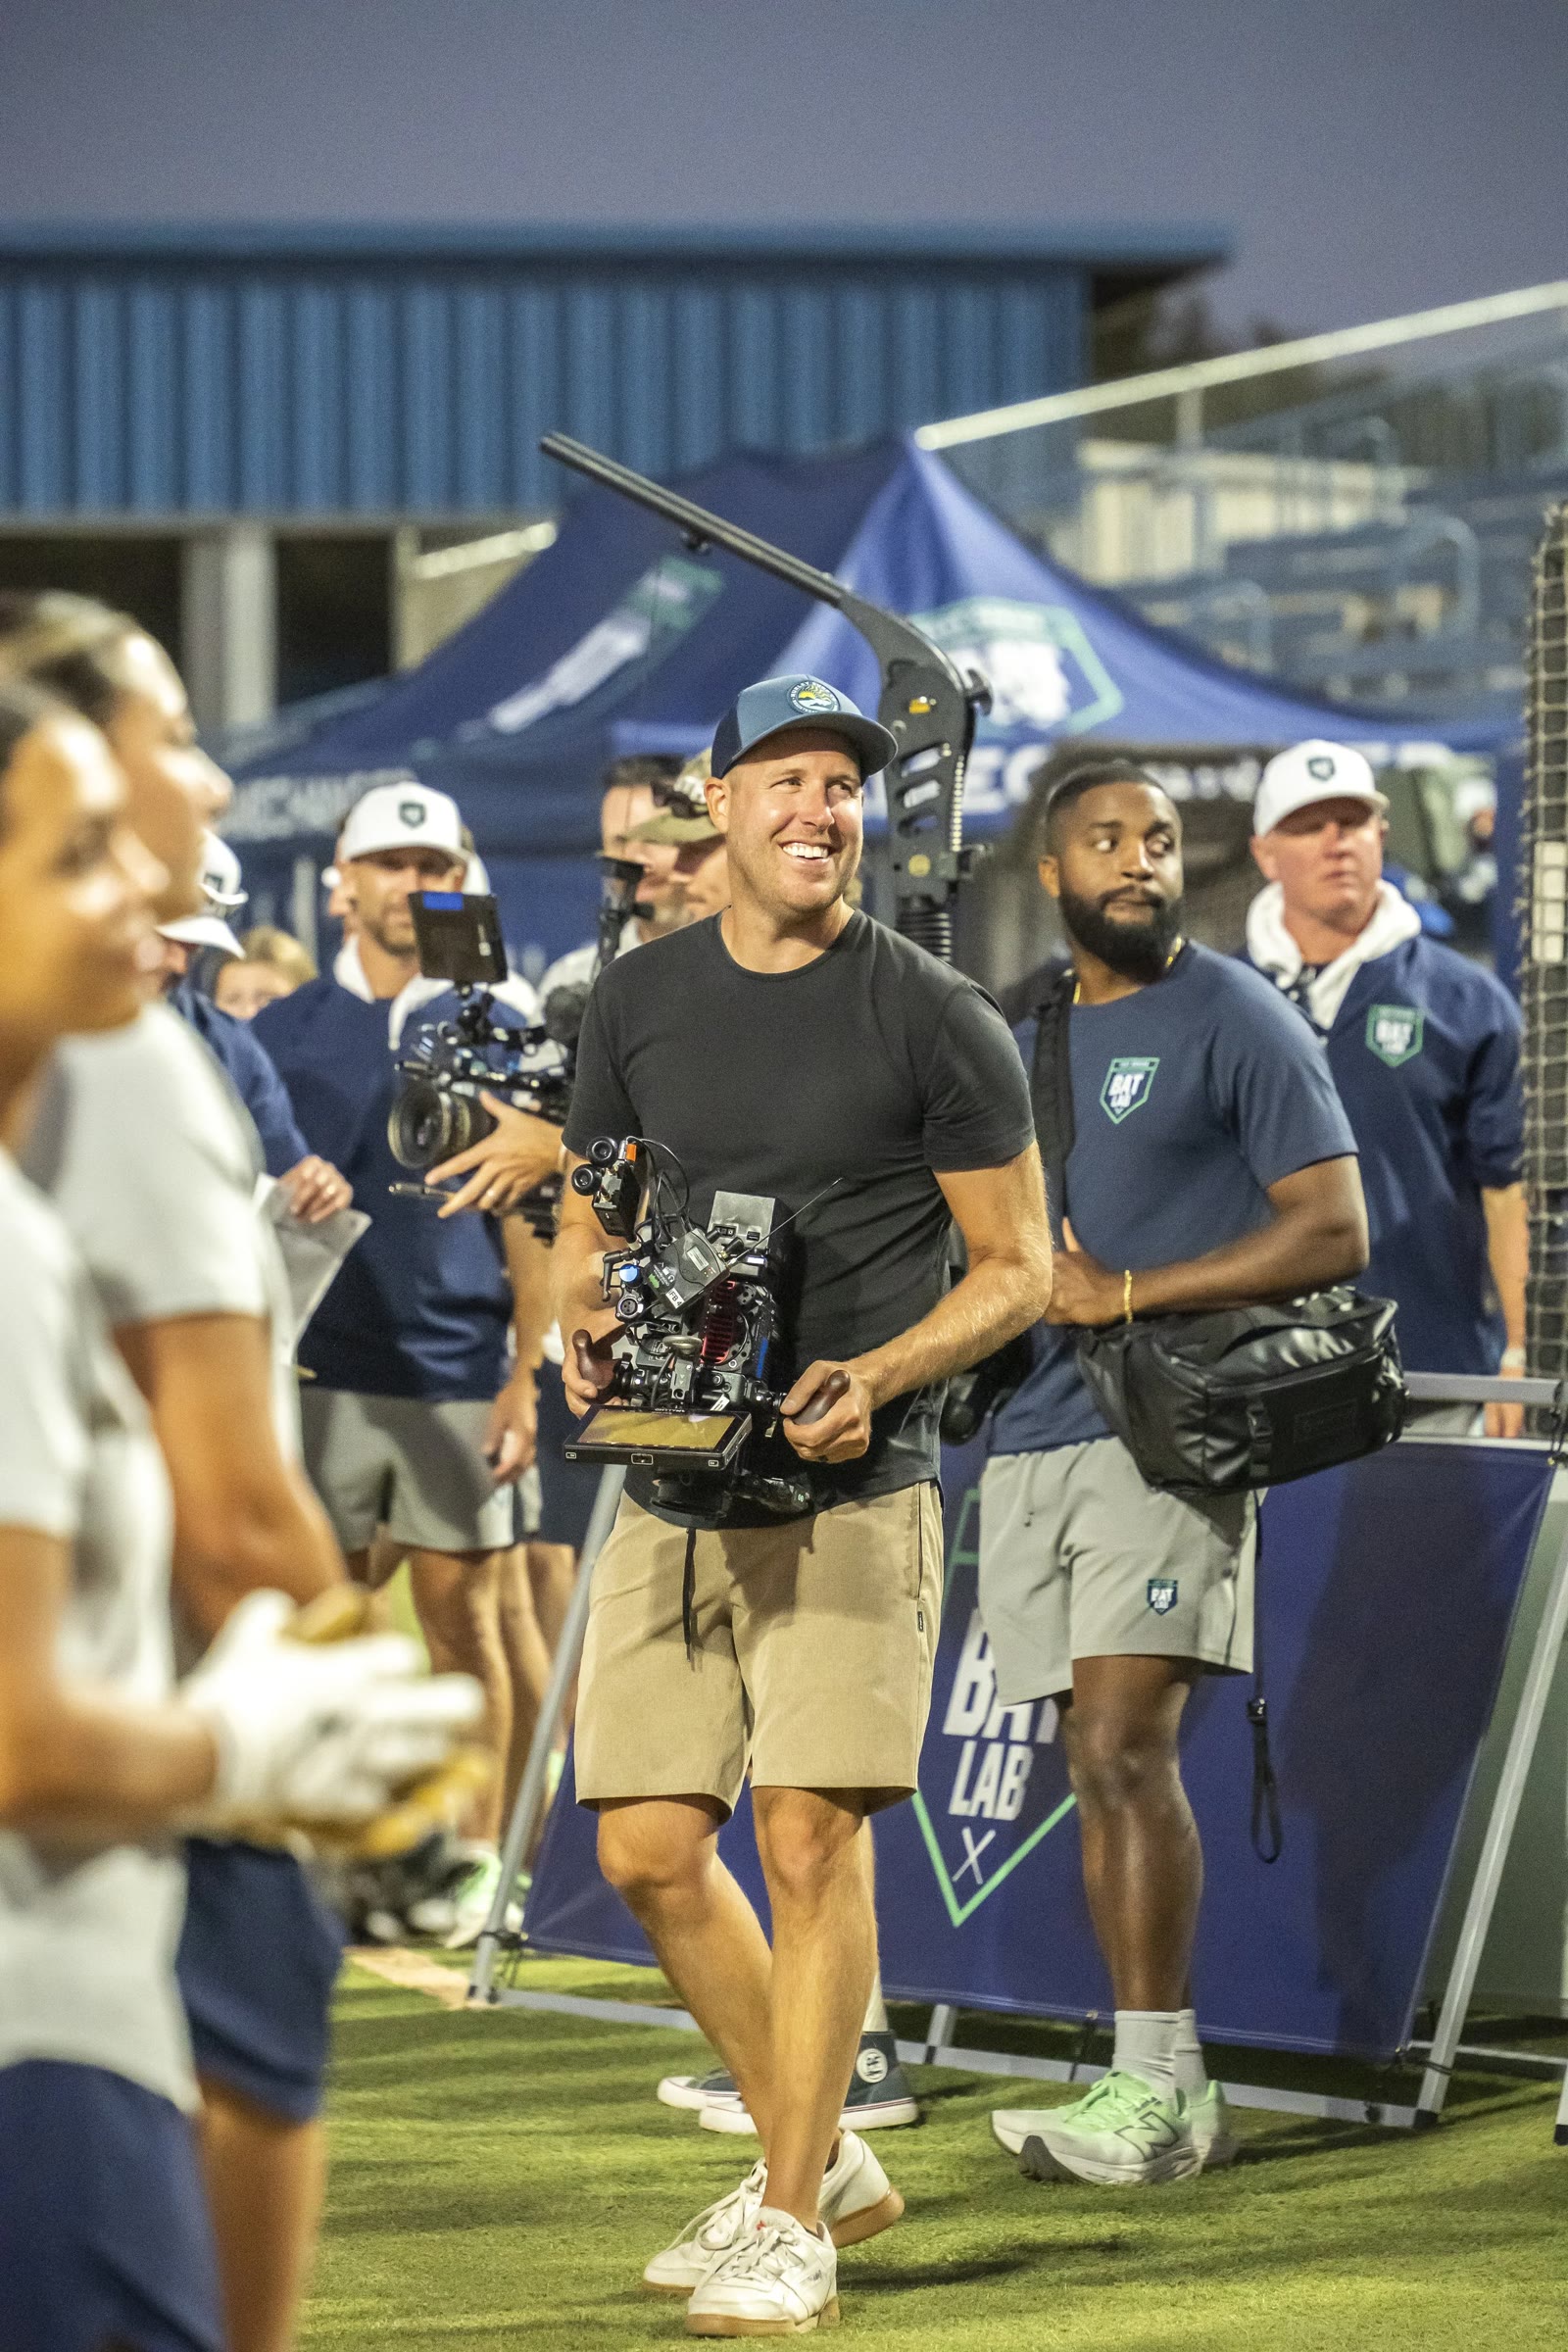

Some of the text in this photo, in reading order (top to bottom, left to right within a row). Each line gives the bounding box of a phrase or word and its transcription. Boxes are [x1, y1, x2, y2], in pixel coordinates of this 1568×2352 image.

[1108, 1073, 1145, 1096] BAT
[1110, 1093, 1131, 1108] LAB
[1151, 1588, 1174, 1602] BAT
[948, 1740, 1034, 1821] LAB
